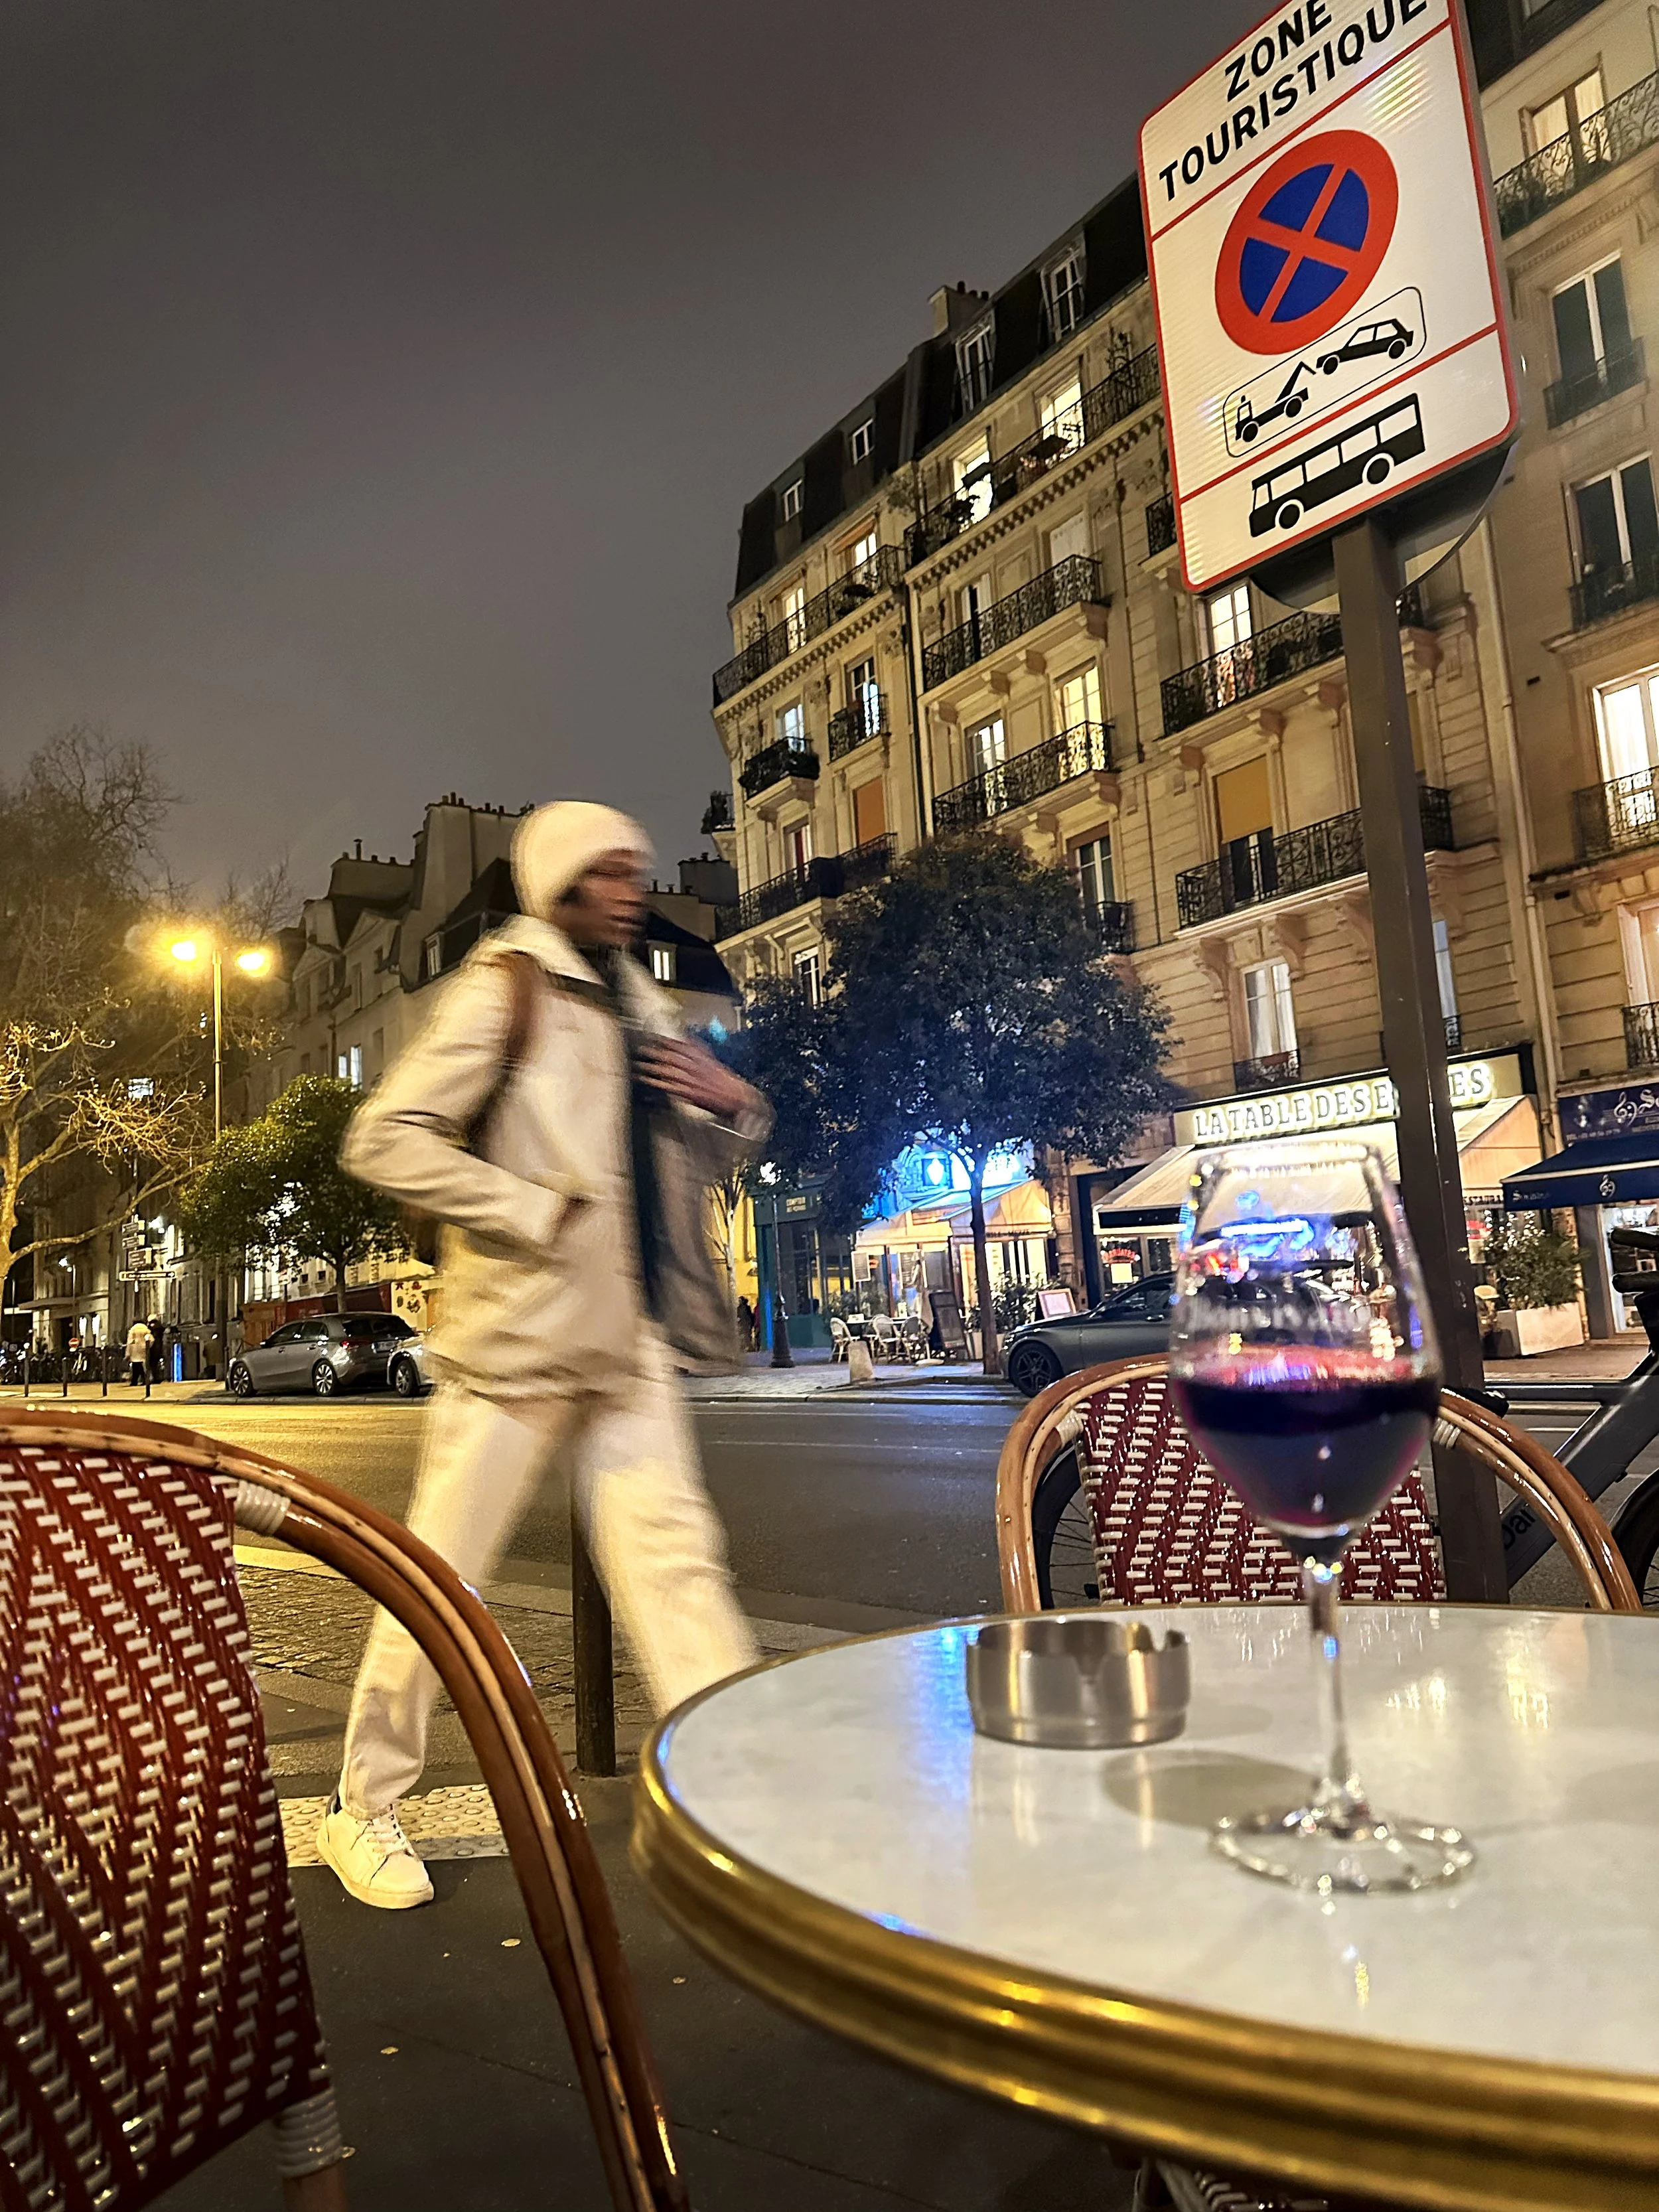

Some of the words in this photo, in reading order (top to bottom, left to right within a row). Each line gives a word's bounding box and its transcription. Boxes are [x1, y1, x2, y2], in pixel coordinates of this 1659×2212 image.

[1159, 0, 1427, 202] TOURISTIQUE
[1225, 0, 1332, 102] ZONE
[1195, 1112, 1224, 1137] LA
[1228, 1097, 1307, 1132] TABLE
[1316, 1088, 1366, 1118] DES
